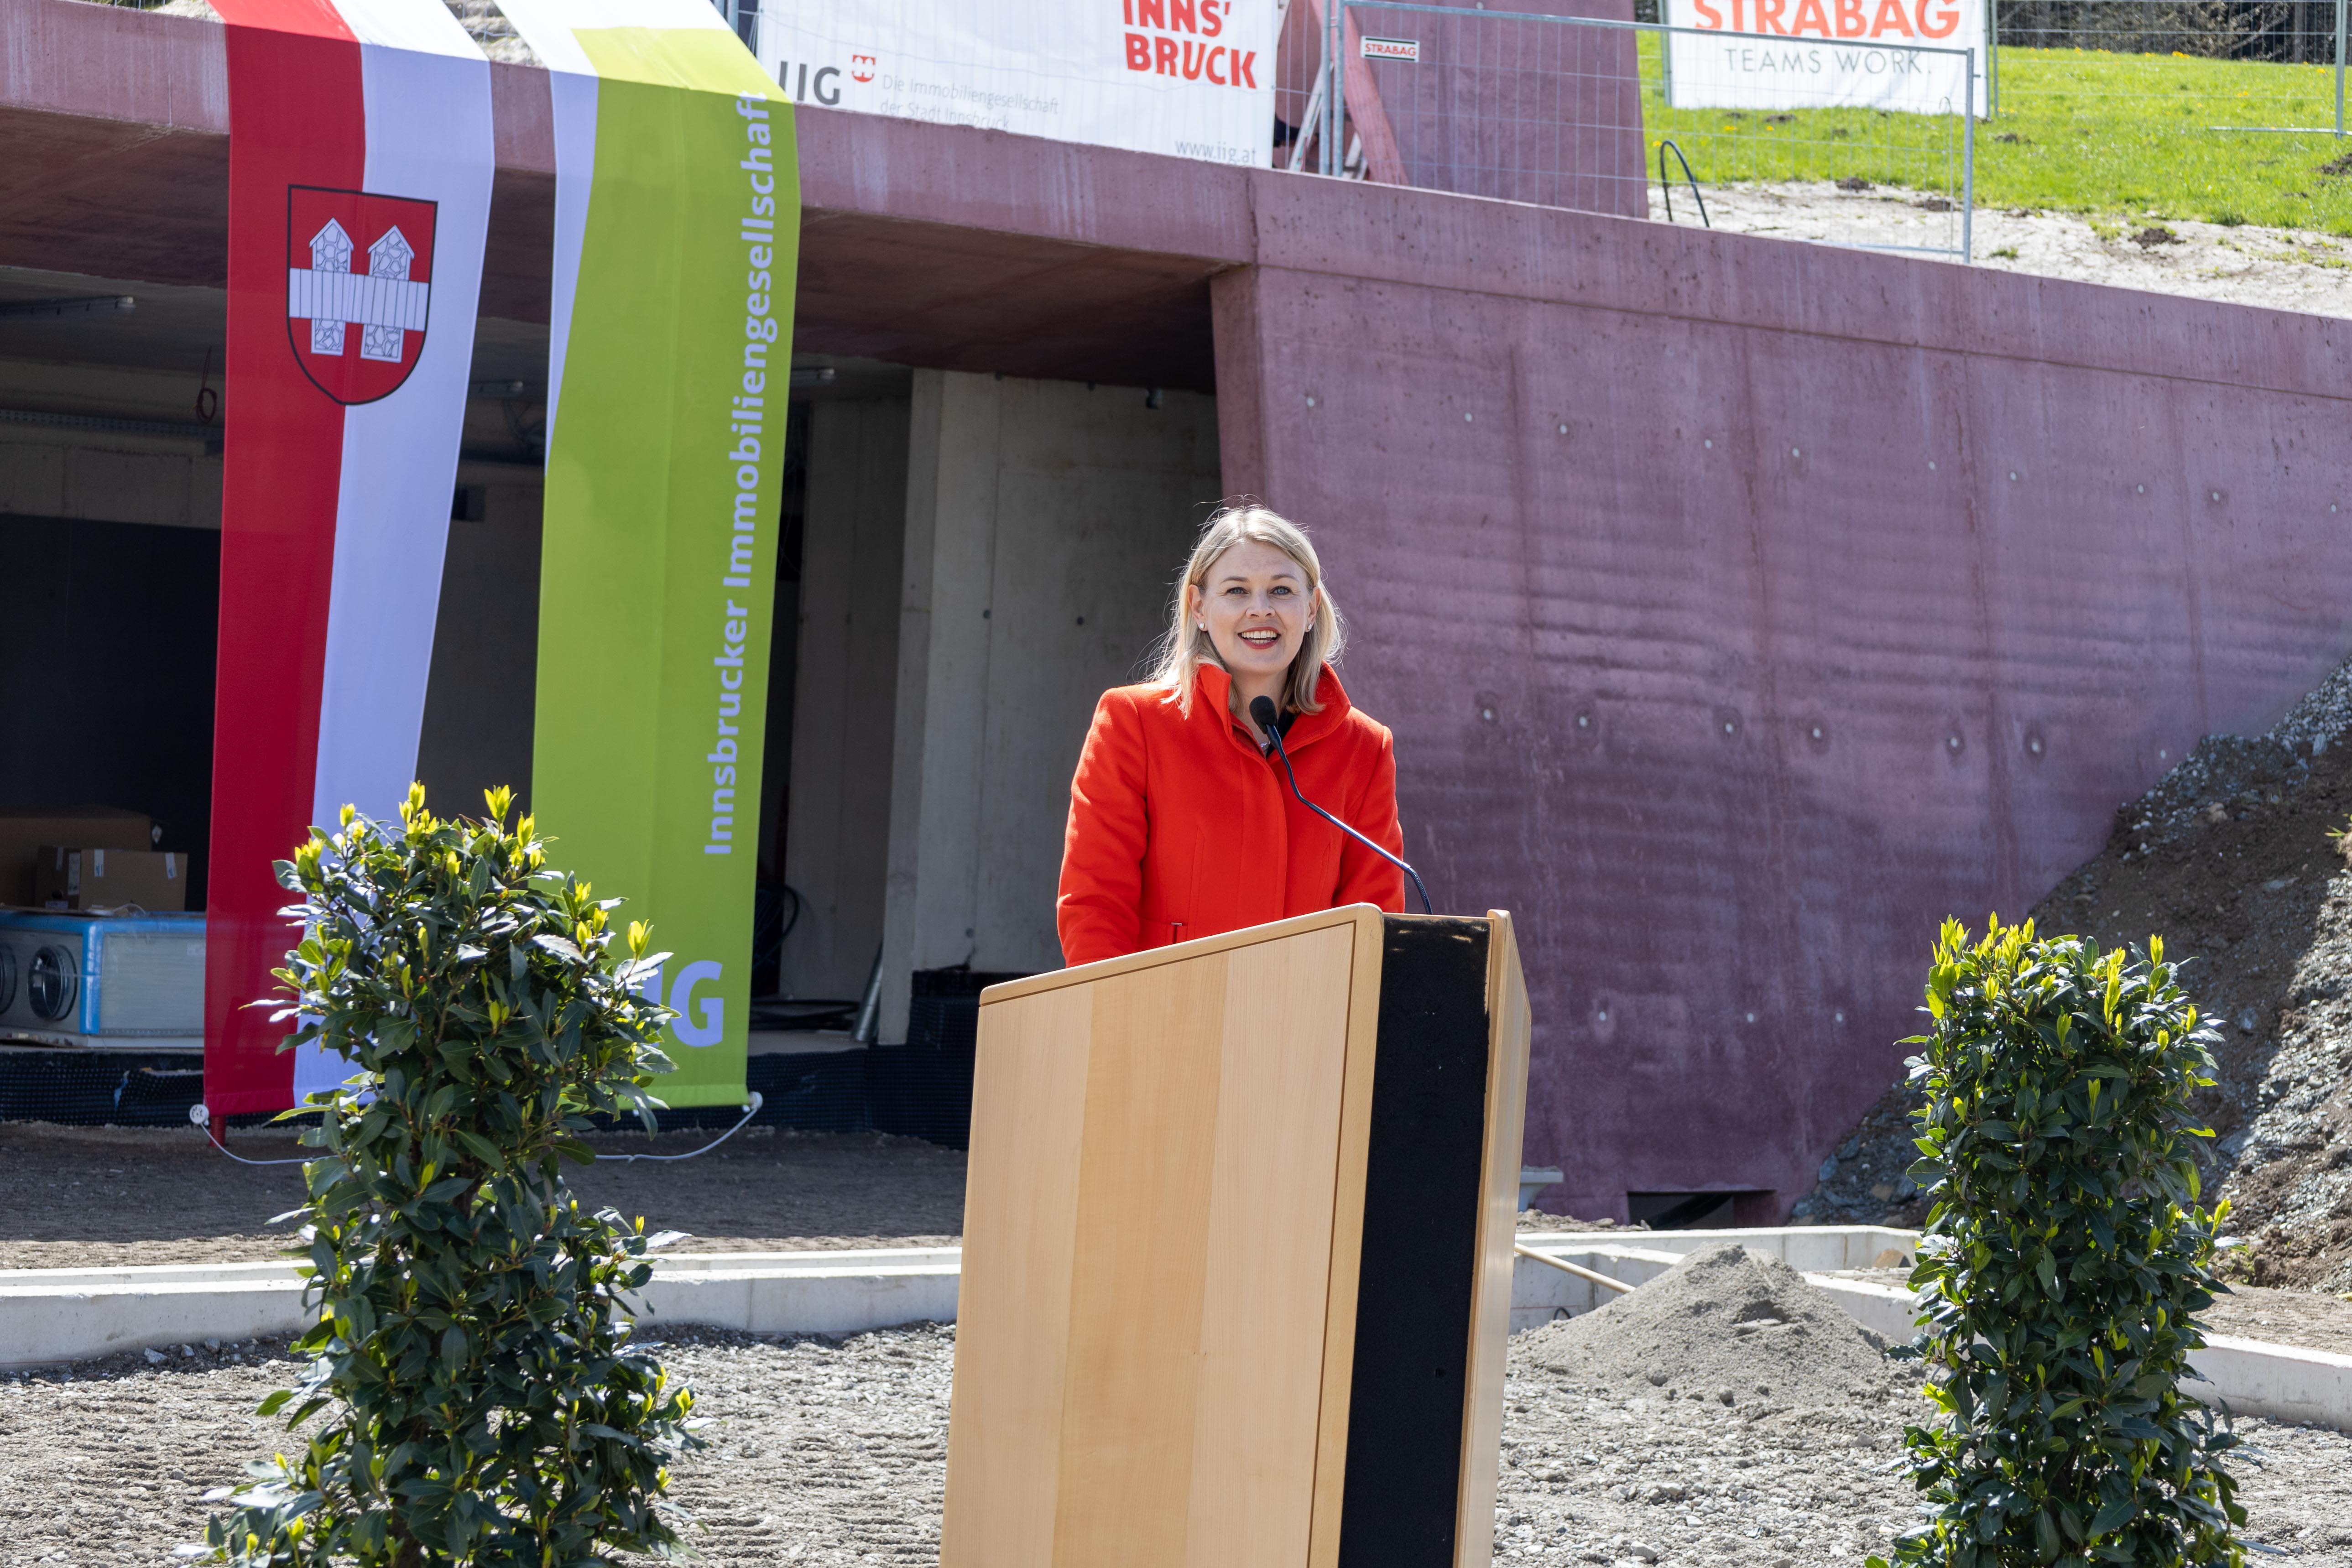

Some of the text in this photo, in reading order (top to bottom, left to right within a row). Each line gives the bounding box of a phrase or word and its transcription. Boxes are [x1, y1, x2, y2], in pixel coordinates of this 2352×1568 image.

[1123, 0, 1231, 37] INNS'
[1125, 32, 1257, 89] BRUCK
[1365, 43, 1416, 56] STRABAG
[1724, 48, 1932, 74] TEAMS WORK.
[778, 61, 841, 105] IIG
[883, 74, 1059, 115] Die Immobiliengesellschaft
[880, 99, 902, 115] der
[907, 102, 941, 122] Stadt
[1174, 140, 1257, 165] www.iig.at
[704, 90, 778, 854] Innsbrucker Immobiliengesellschaft
